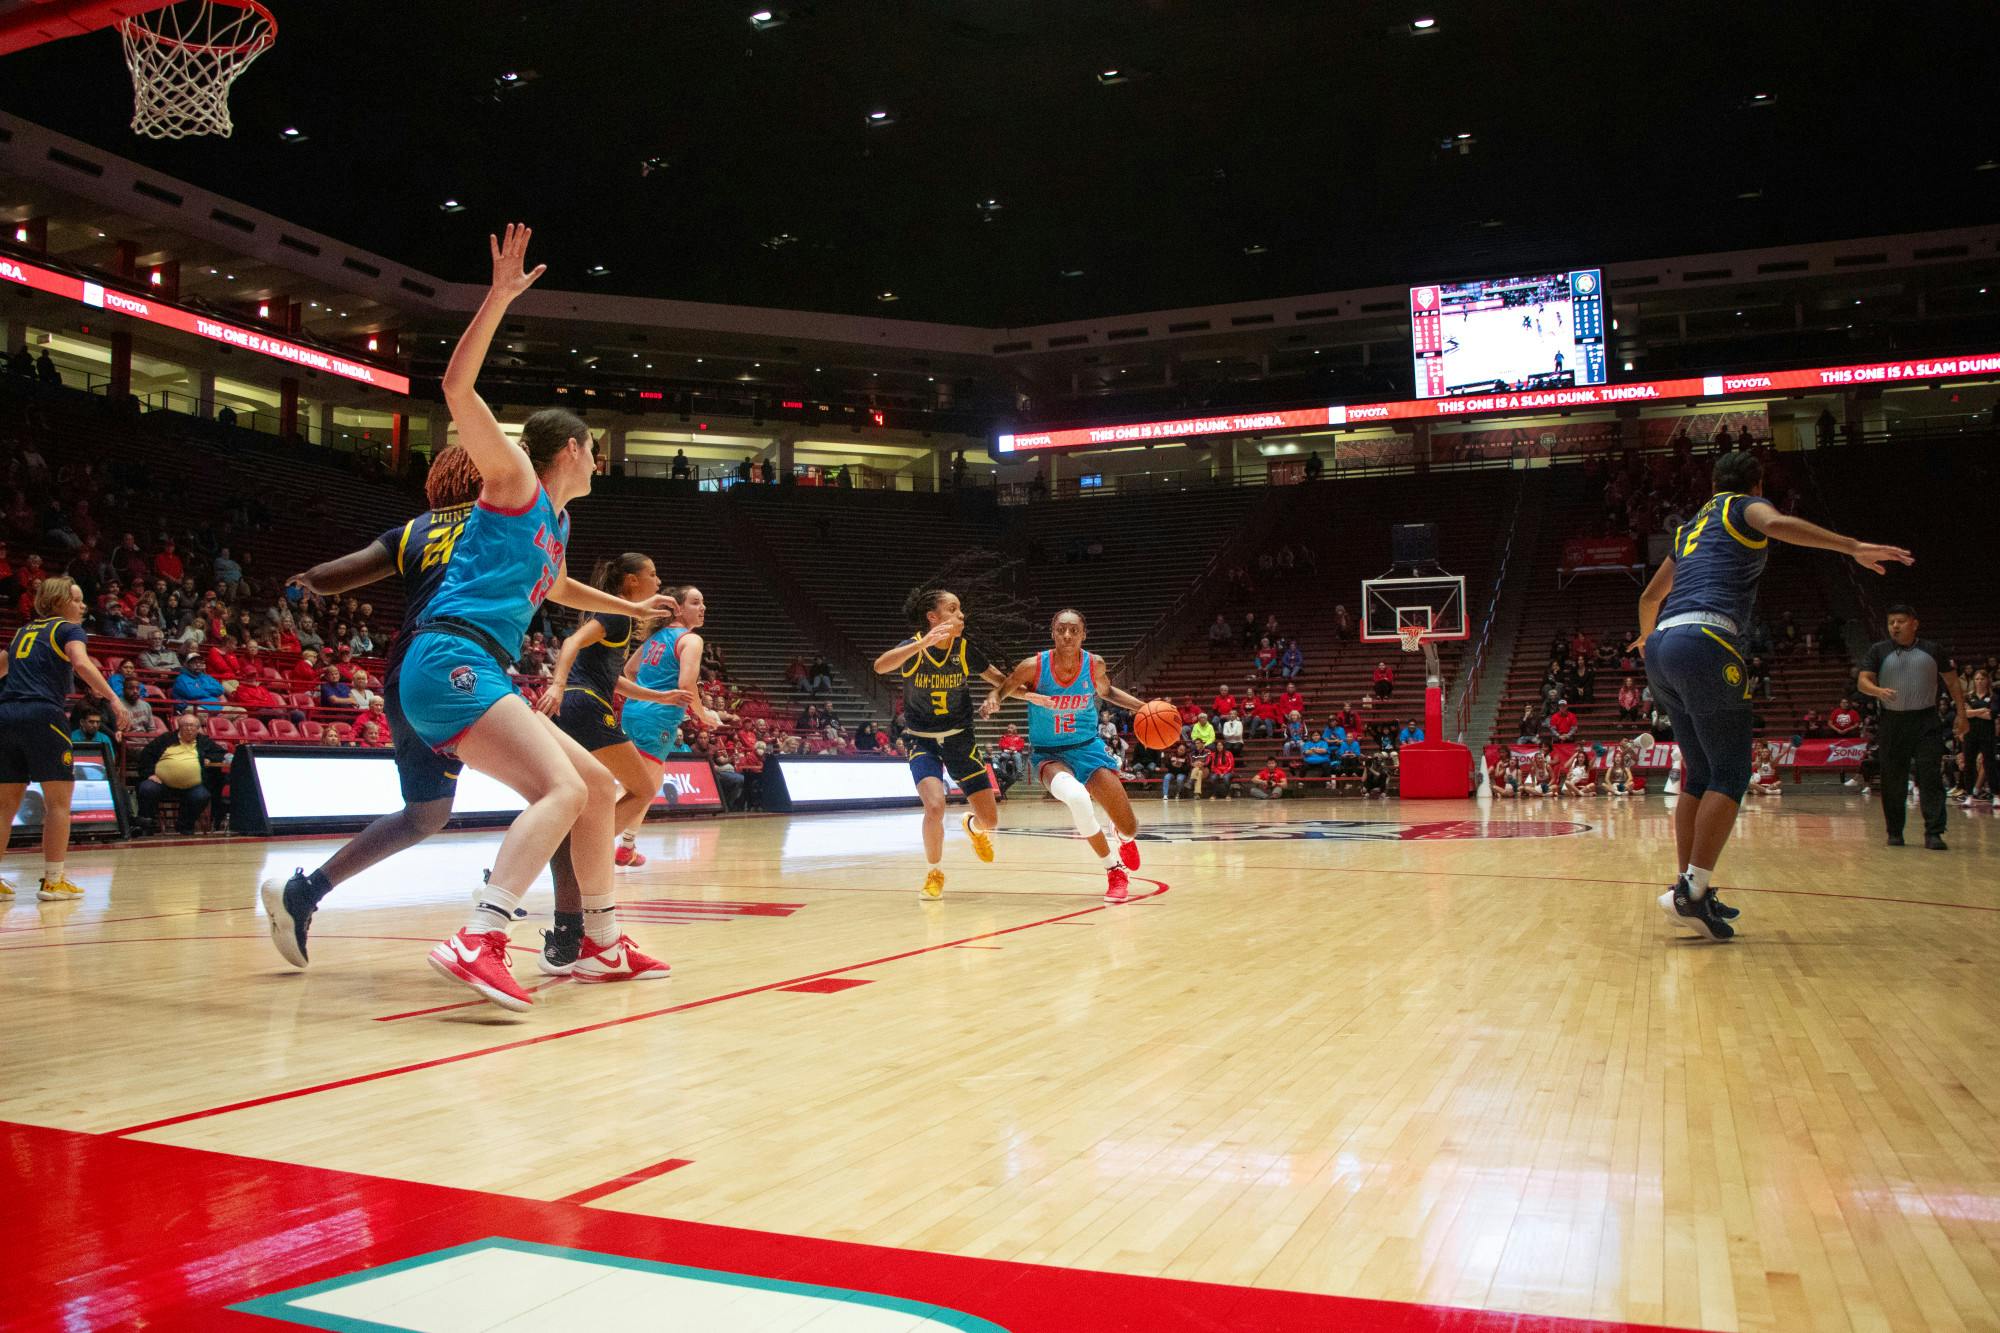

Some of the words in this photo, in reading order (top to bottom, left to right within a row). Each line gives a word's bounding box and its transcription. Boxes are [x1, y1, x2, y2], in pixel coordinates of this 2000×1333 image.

[105, 293, 148, 315] TOYOTA
[196, 319, 223, 338] THIS
[223, 328, 248, 346] ONE
[248, 335, 260, 350] IS
[260, 339, 269, 352] A
[269, 341, 299, 361] SLAM
[299, 351, 331, 370] DUNK.
[332, 360, 374, 382] TUNDRA.
[1725, 377, 1771, 390] TOYOTA
[1820, 370, 1852, 384] THIS
[1854, 367, 1886, 382] ONE
[1887, 366, 1901, 379] IS
[1903, 365, 1914, 377] A
[1915, 361, 1956, 376] SLAM
[1437, 400, 1465, 414] THIS
[1466, 398, 1494, 412] ONE
[1495, 397, 1507, 409] IS
[1509, 396, 1520, 408] A
[1521, 393, 1556, 407] SLAM
[1557, 390, 1599, 404] DUNK.
[1602, 386, 1660, 400] TUNDRA.
[875, 414, 883, 425] 4
[1348, 407, 1389, 418] TOYOTA
[1090, 430, 1115, 442] THIS
[1116, 428, 1140, 440] ONE
[1140, 427, 1152, 438] IS
[1152, 425, 1162, 436] A
[1163, 423, 1194, 435] SLAM
[1195, 419, 1233, 433] DUNK.
[1233, 416, 1286, 430] TUNDRA.
[1016, 436, 1051, 447] TOYOTA
[1683, 515, 1709, 557] 2
[15, 631, 39, 659] 0
[930, 691, 949, 716] 3
[1050, 695, 1089, 711] OBOS
[1054, 713, 1077, 735] 12
